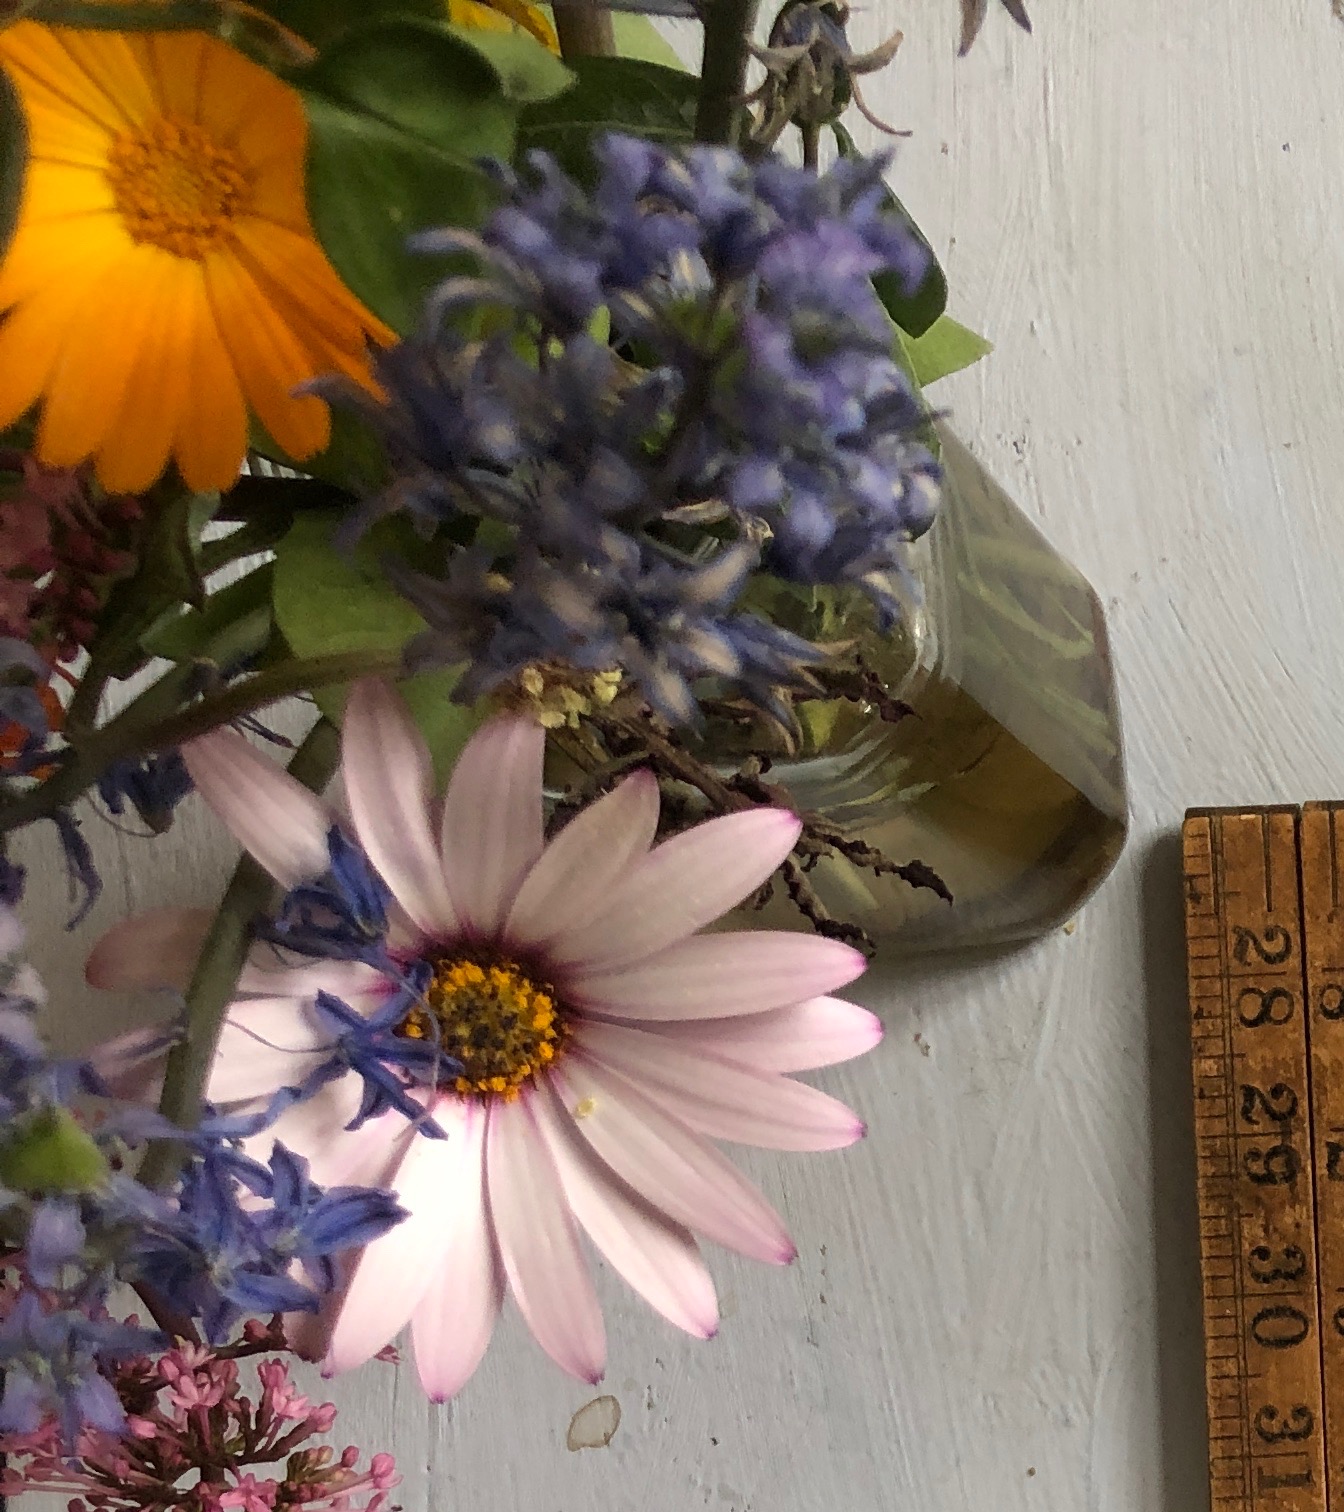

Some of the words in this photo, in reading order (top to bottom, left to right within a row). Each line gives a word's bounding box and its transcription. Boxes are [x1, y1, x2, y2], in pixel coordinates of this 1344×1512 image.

[1231, 924, 1295, 1029] 28
[1239, 1082, 1299, 1186] 29
[1247, 1244, 1310, 1348] 30
[1253, 1404, 1317, 1492] 31
